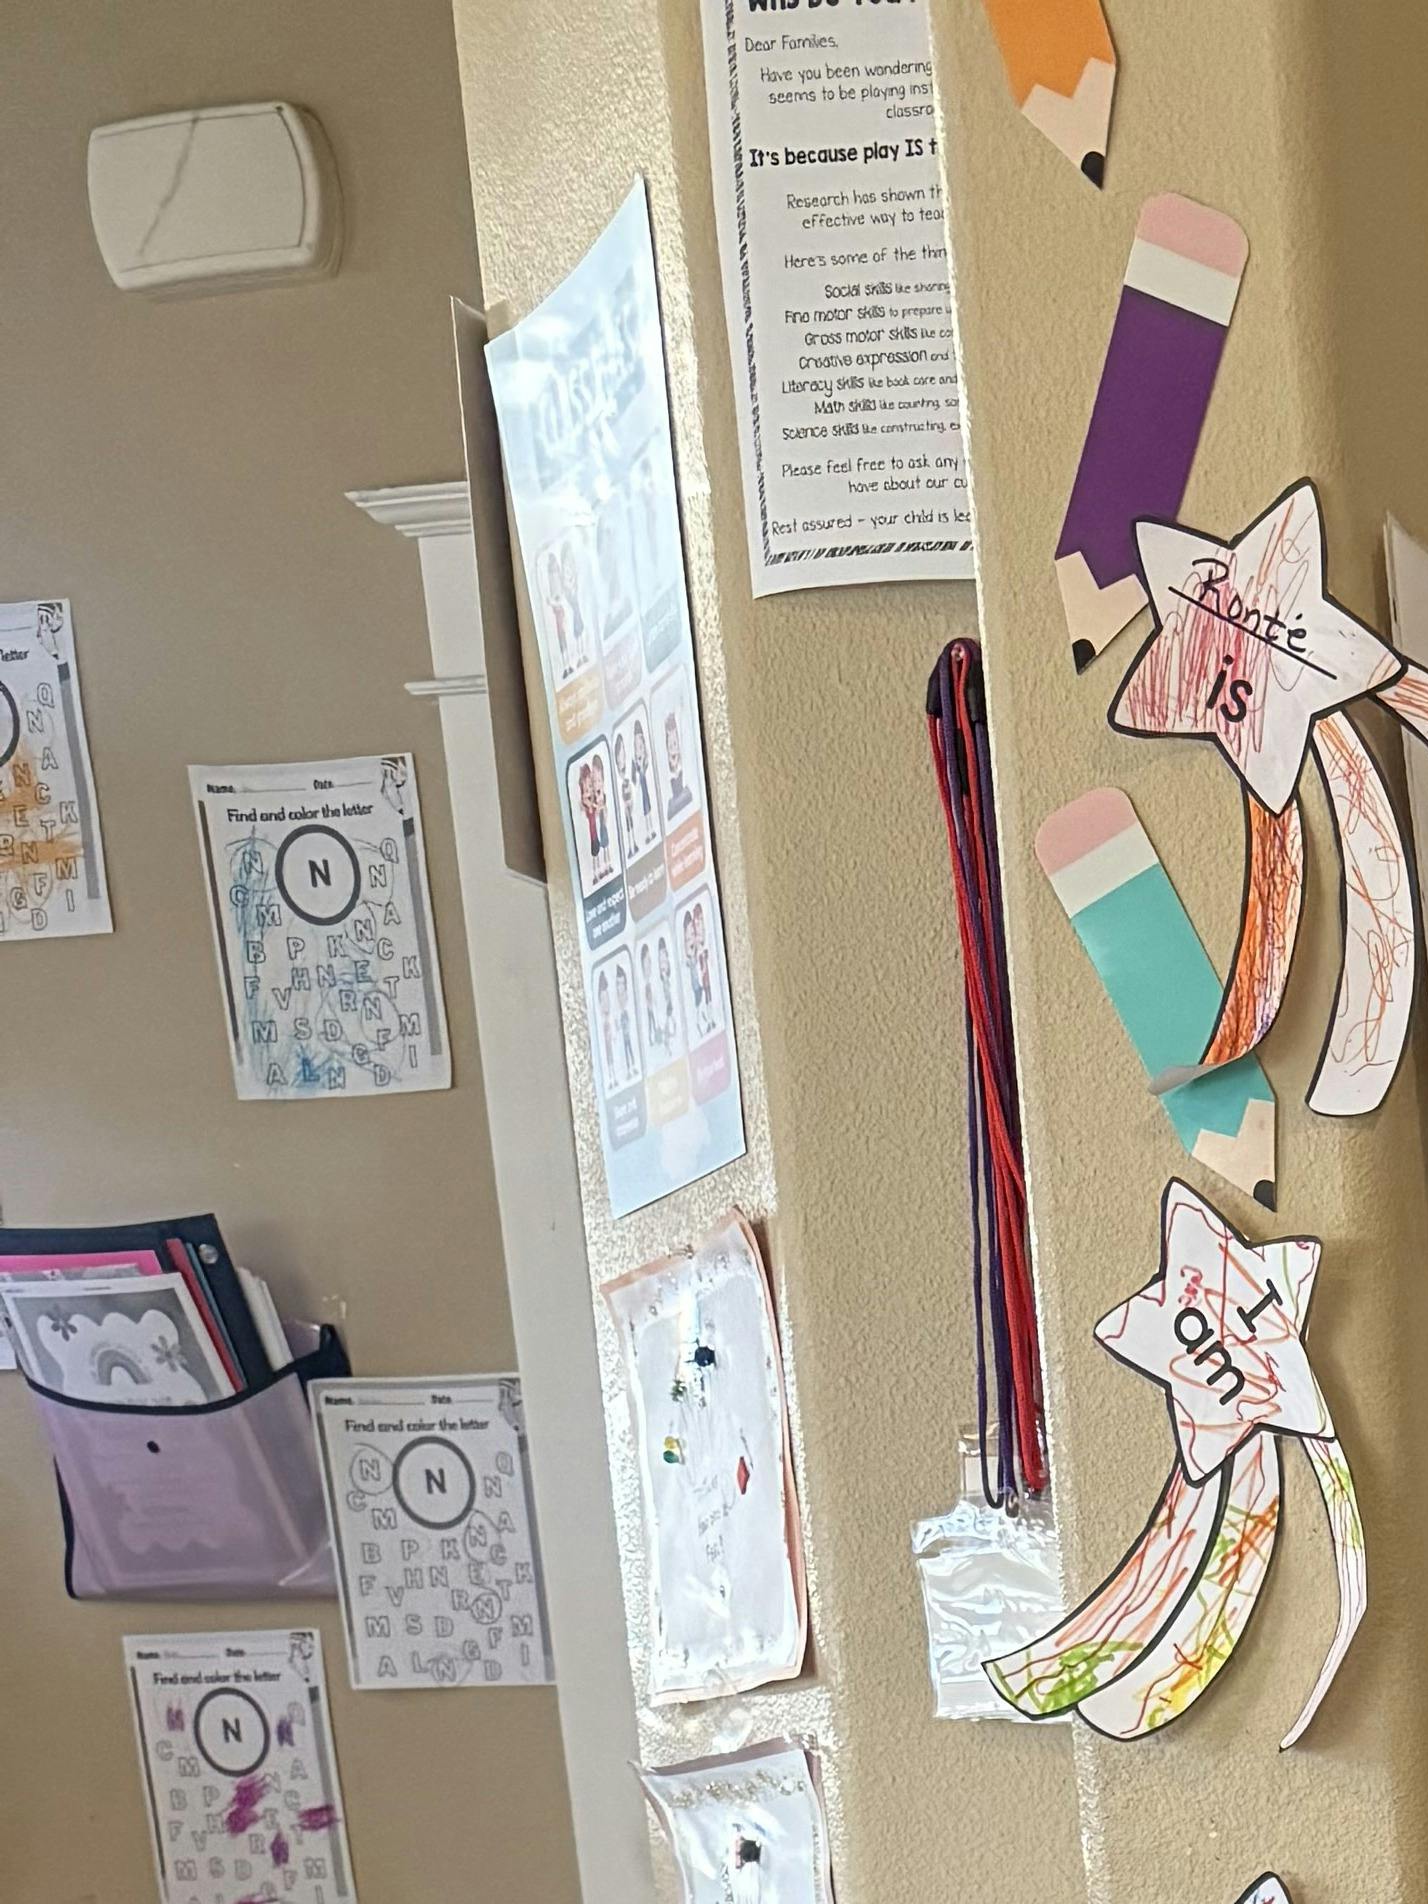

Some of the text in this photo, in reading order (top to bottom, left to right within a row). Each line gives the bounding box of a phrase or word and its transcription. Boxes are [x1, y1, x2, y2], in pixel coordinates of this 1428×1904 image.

[745, 36, 777, 52] Dear
[760, 60, 932, 84] Have you been wondering
[768, 82, 906, 104] seems to be playing
[749, 148, 780, 167] It's
[784, 145, 858, 165] because
[864, 142, 900, 164] play
[904, 139, 923, 157] IS
[787, 187, 925, 209] Research has shown
[802, 211, 865, 229] effective
[870, 212, 896, 227] way
[902, 208, 914, 222] to
[784, 253, 827, 269] Here's
[831, 251, 868, 265] some
[872, 247, 889, 263] of
[894, 246, 917, 261] the
[824, 283, 861, 299] Social
[864, 281, 893, 295] skills
[785, 310, 810, 324] Fine
[813, 307, 852, 322] motor
[857, 306, 885, 320] skills
[901, 305, 943, 319] prepare
[804, 331, 842, 346] Gross
[845, 329, 885, 344] motor
[888, 327, 918, 341] skills
[799, 355, 853, 370] Creative
[855, 349, 928, 371] expression
[781, 378, 833, 398] Literacy
[836, 375, 865, 391] skills
[814, 400, 845, 414] Math
[848, 398, 877, 413] skills
[782, 426, 828, 441] Science
[832, 422, 859, 437] skills
[782, 454, 959, 478] Please feel free to ask any
[848, 479, 879, 494] have
[883, 476, 921, 492] about
[926, 477, 949, 489] our
[772, 518, 797, 537] Rest
[802, 514, 852, 532] assured
[869, 511, 897, 530] your
[904, 509, 934, 525] child
[938, 511, 949, 524] is
[1206, 654, 1253, 722] is
[226, 803, 374, 824] Find and color the letter
[308, 859, 333, 888] N
[1236, 1279, 1283, 1335] I
[1173, 1306, 1247, 1406] am
[425, 1468, 448, 1495] N
[222, 1717, 242, 1743] N
